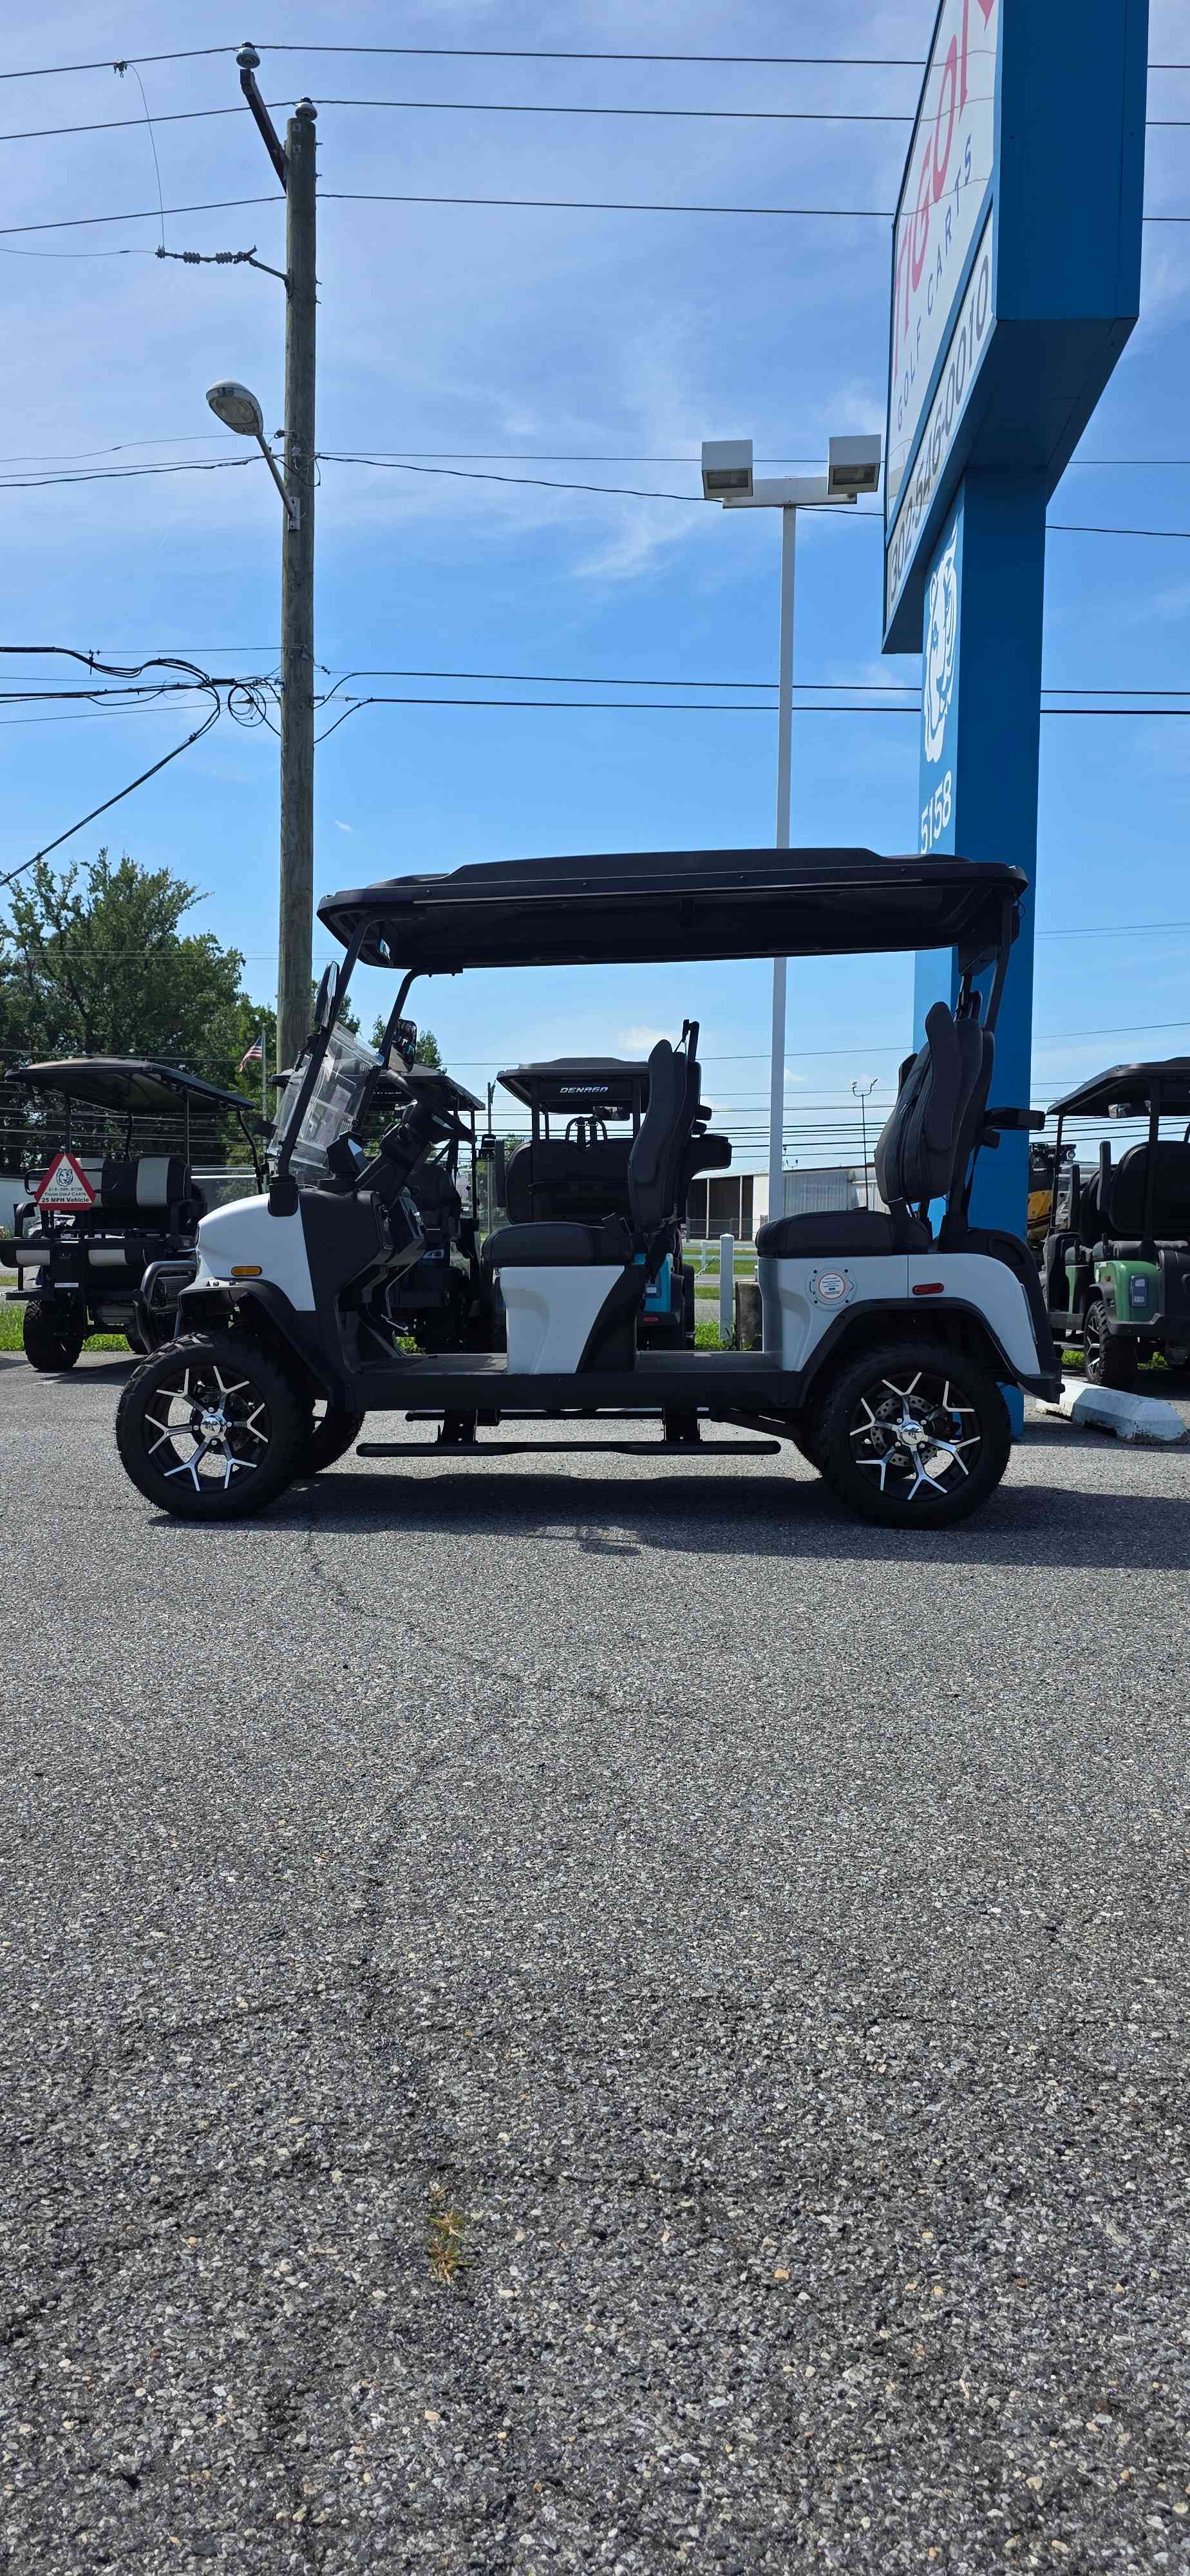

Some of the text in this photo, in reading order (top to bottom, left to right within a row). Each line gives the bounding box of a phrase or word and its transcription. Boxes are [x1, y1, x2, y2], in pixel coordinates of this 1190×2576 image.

[891, 254, 989, 602] 302-546-0010
[898, 133, 971, 432] GOLF CARTS
[920, 770, 952, 854] 5158
